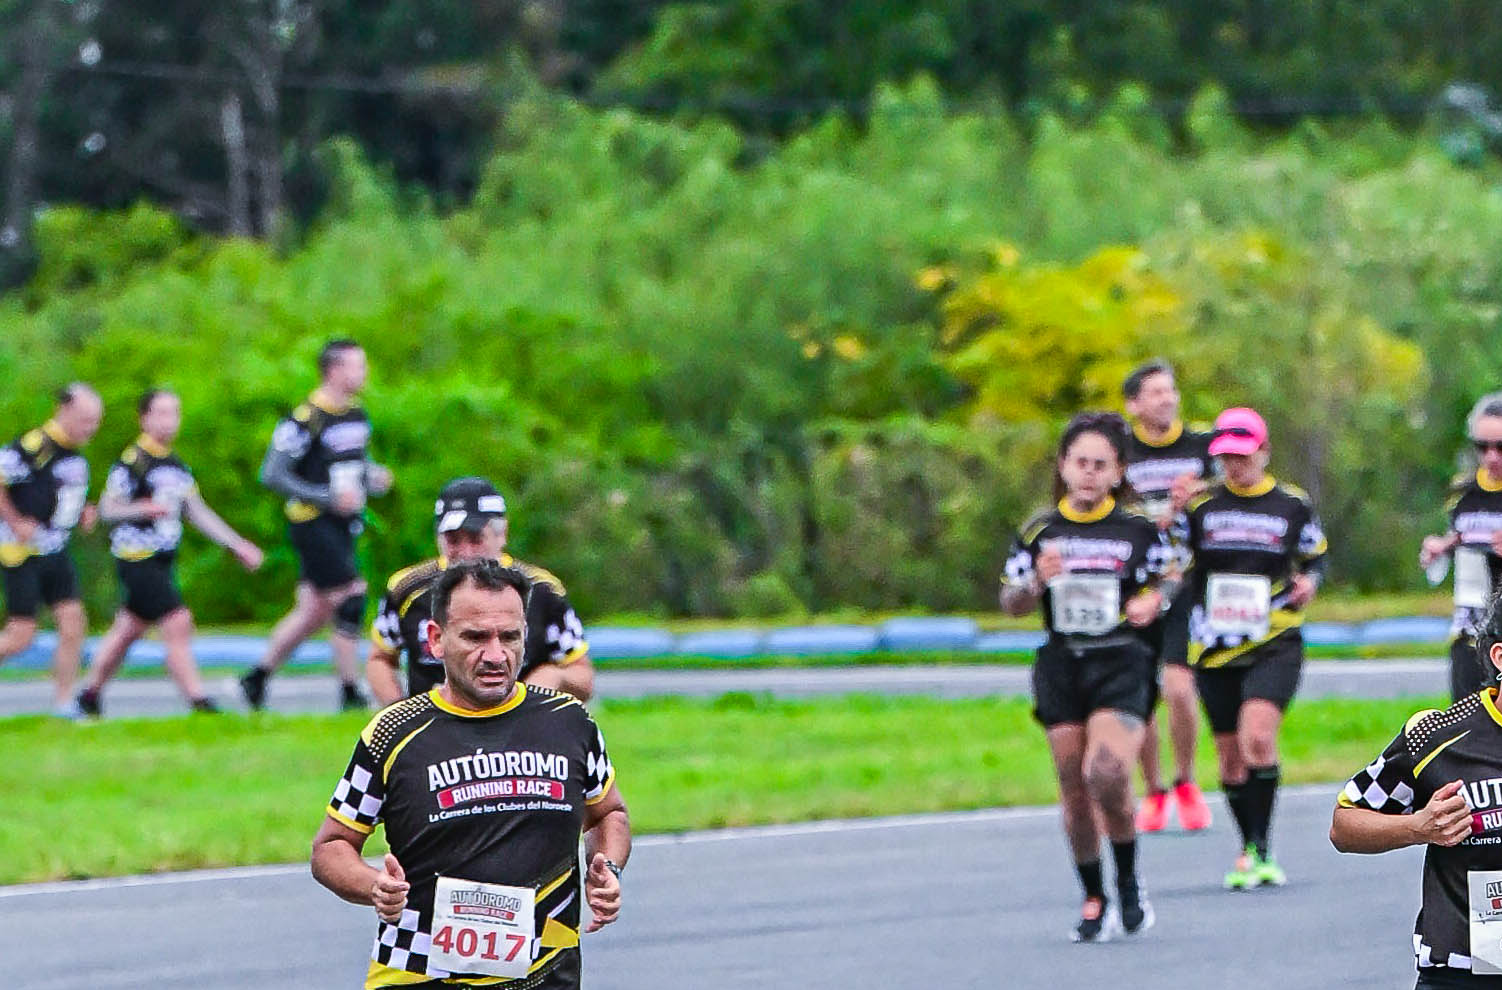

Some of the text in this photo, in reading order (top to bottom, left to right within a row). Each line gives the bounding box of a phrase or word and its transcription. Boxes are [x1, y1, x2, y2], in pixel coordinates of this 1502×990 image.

[427, 748, 569, 792] AUTÓDROMO
[452, 780, 552, 804] RUNNING RACE
[1470, 835, 1501, 845] Carrera
[450, 888, 521, 912] AUTÓDROMO
[433, 926, 526, 962] 4017
